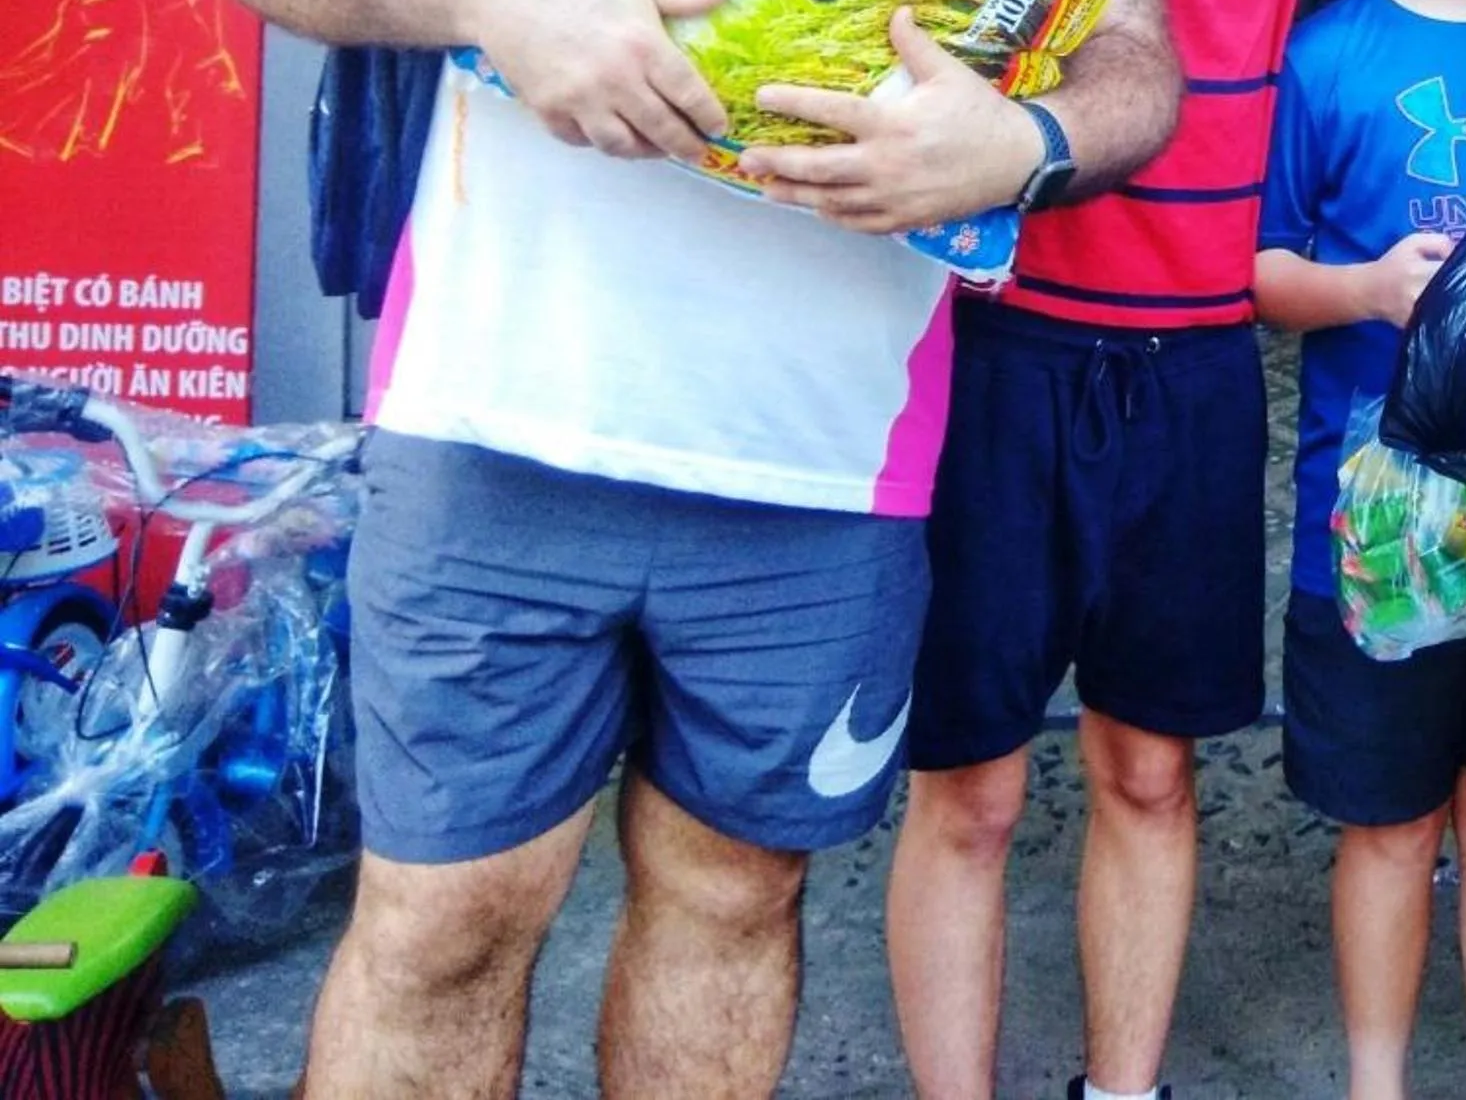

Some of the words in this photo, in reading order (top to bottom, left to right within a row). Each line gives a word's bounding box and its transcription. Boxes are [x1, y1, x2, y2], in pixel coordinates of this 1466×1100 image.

[2, 272, 70, 312] BIỆT
[73, 273, 113, 307] CÓ
[118, 275, 204, 310] BÁNH
[58, 322, 135, 352] DINH
[142, 320, 248, 354] DƯỠNG
[128, 362, 171, 397] ĂN
[177, 364, 247, 399] KIÊN
